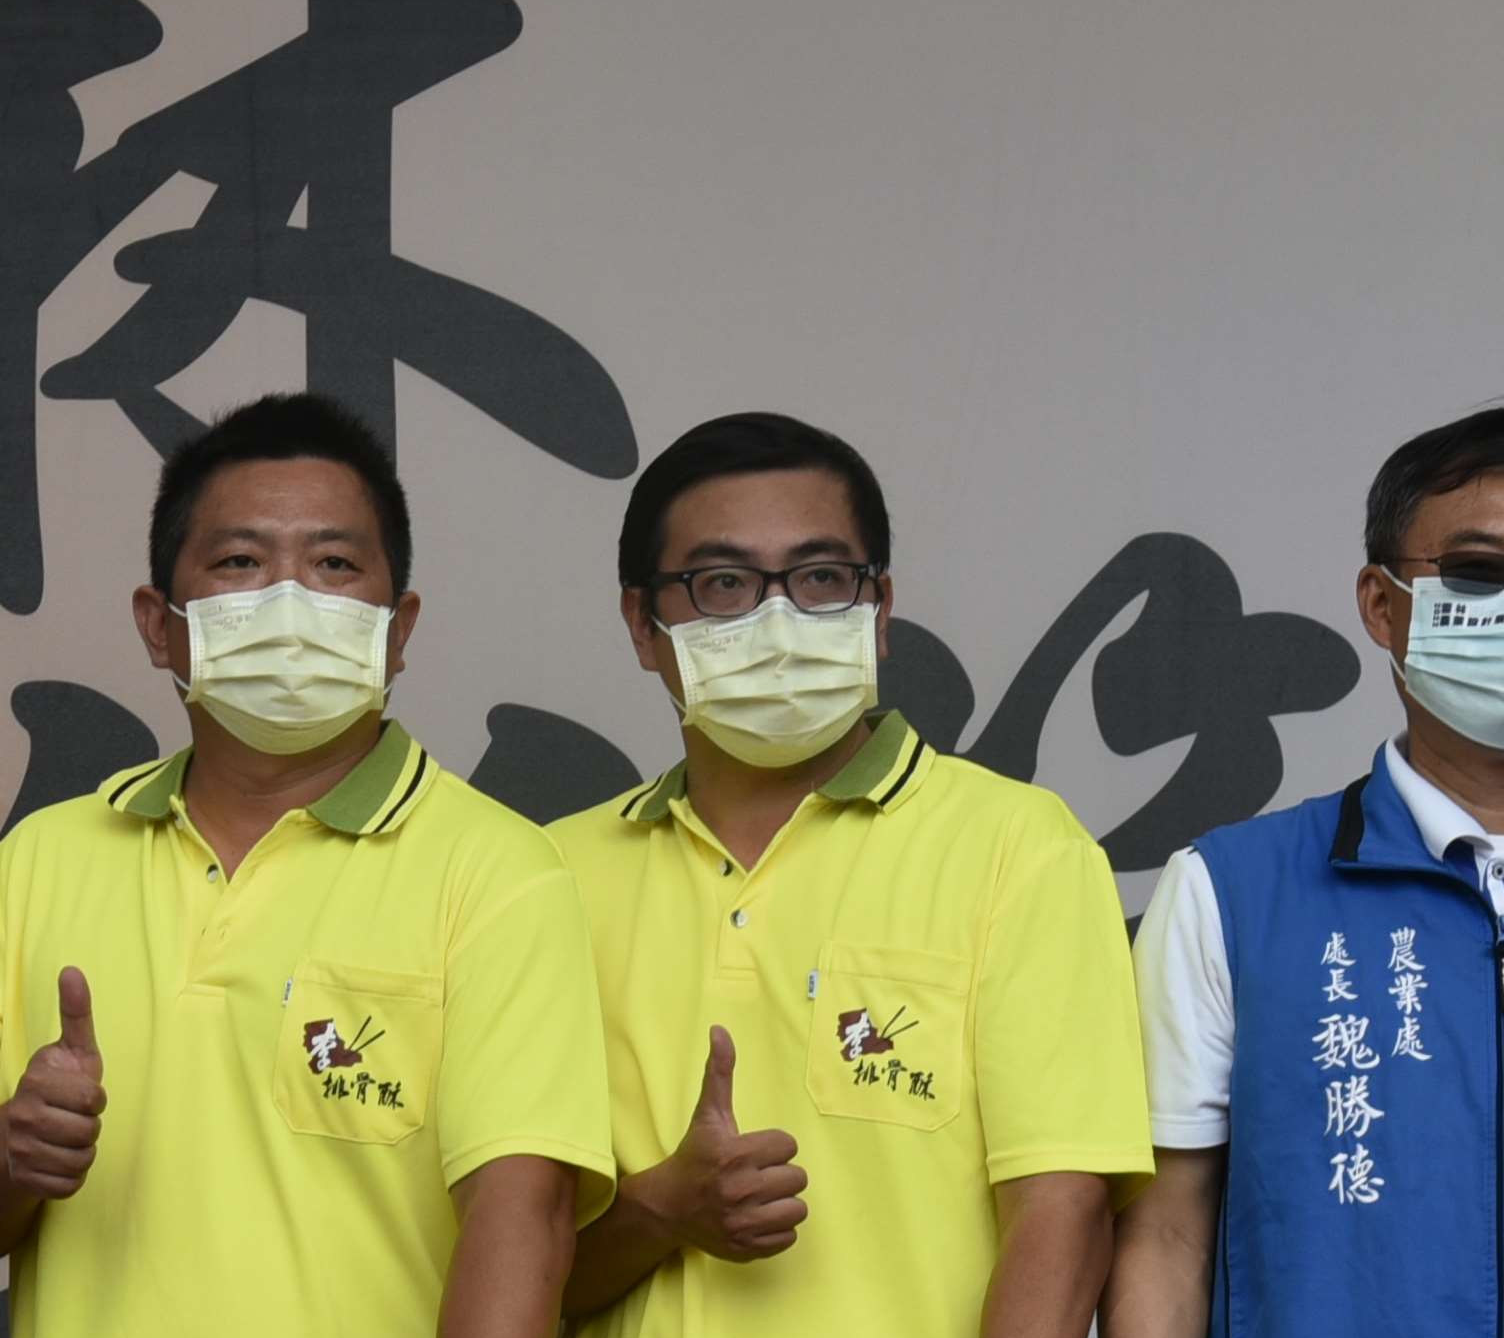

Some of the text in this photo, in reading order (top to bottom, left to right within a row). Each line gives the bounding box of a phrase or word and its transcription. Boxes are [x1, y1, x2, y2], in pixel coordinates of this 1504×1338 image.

[1320, 931, 1359, 1003] 處長
[1387, 926, 1434, 1061] 農業處
